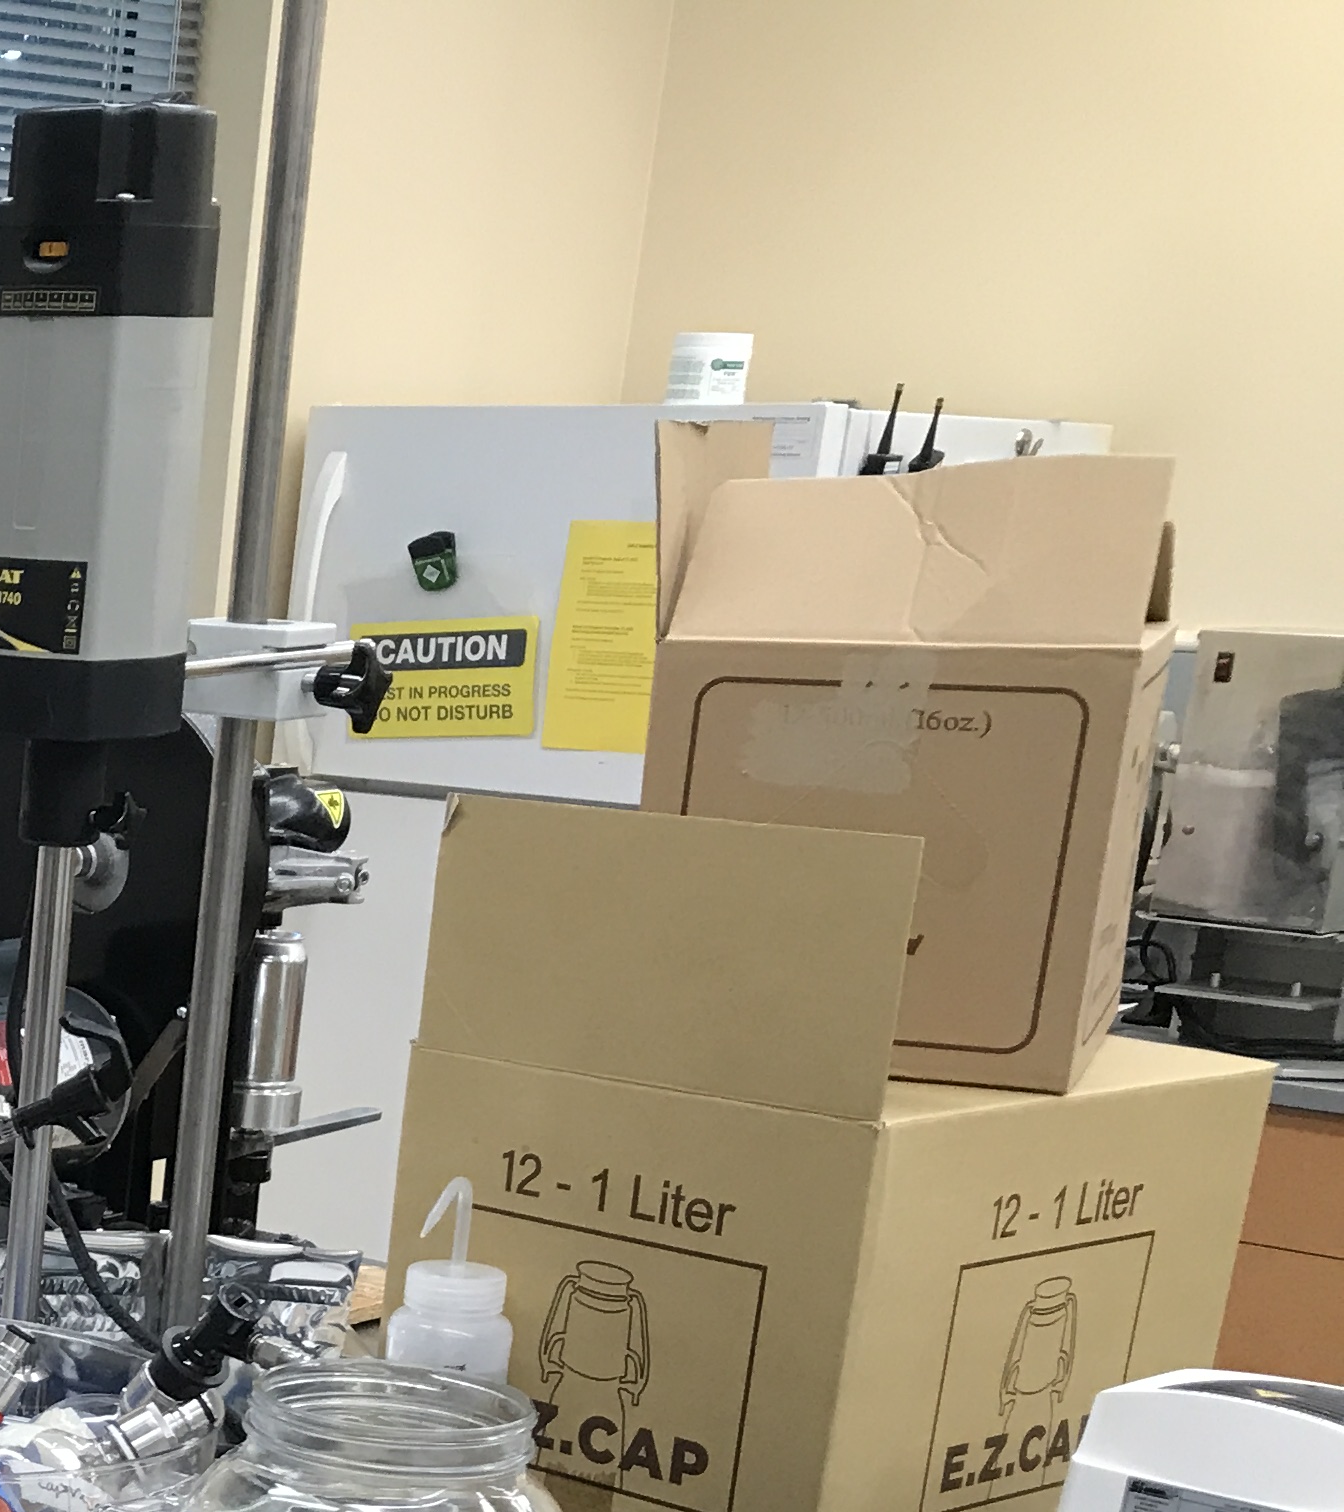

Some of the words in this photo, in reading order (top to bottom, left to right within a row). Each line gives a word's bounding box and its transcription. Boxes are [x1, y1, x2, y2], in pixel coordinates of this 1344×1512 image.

[376, 634, 508, 665] CAUTION
[375, 707, 391, 722] O
[397, 706, 431, 721] NOT
[437, 704, 514, 720] DISTURB
[409, 686, 423, 699] IN
[428, 684, 511, 699] PROGRESS
[911, 709, 992, 738] 16oz.)
[502, 1150, 542, 1197] 12
[556, 1181, 572, 1191] -
[592, 1168, 609, 1212] 1
[629, 1174, 737, 1236] Liter
[992, 1193, 1021, 1240] 12
[1054, 1185, 1068, 1229] 1
[1074, 1178, 1144, 1226] Liter
[530, 1399, 709, 1486] Z.CAP
[940, 1413, 1090, 1494] E.Z.CA
